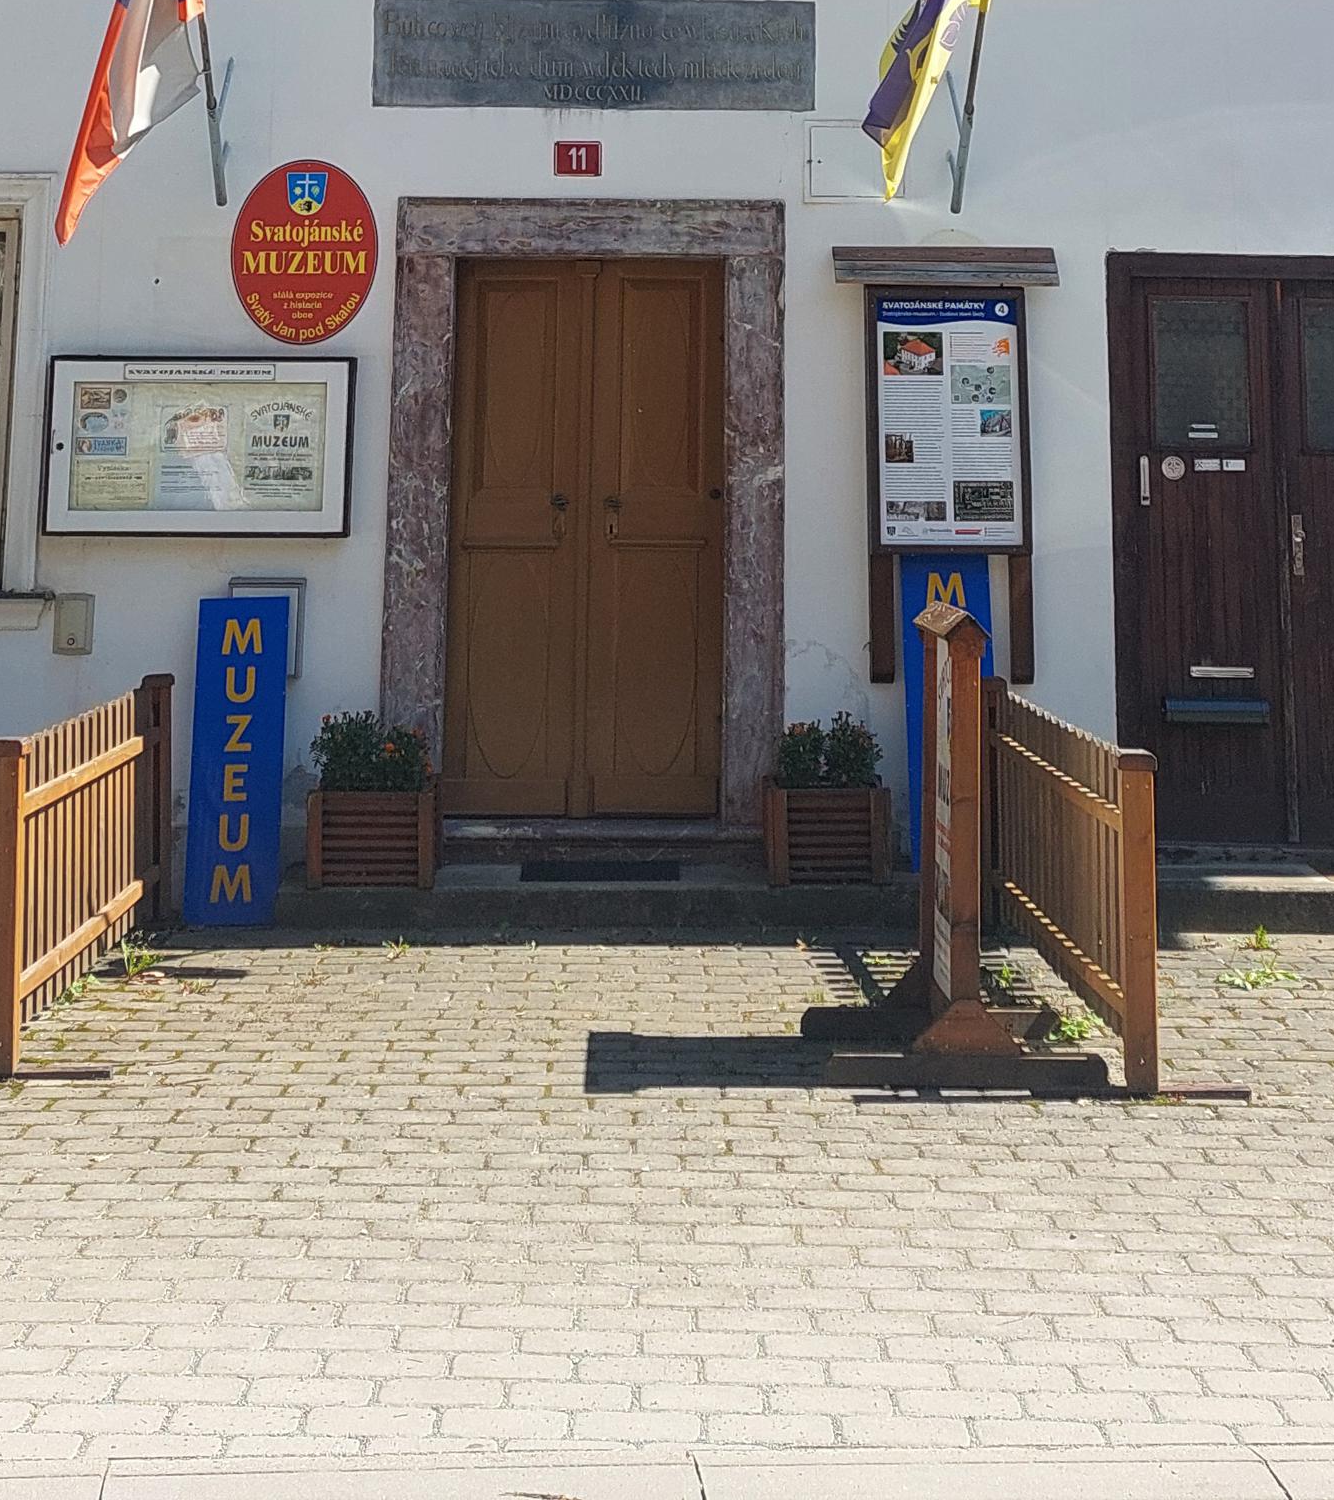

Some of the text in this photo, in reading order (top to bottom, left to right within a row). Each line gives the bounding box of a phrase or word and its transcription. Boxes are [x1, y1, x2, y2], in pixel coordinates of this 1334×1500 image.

[567, 146, 587, 171] 11
[250, 219, 364, 247] Svatojánské
[241, 251, 367, 275] MUZEUM
[882, 299, 986, 310] SVATOJÁNSKÉ PAMÁTKY
[998, 304, 1005, 314] 4
[247, 292, 361, 342] Svatý Jan pod Skalou
[251, 435, 310, 449] MUZEUM
[210, 617, 264, 904] MUZEUM
